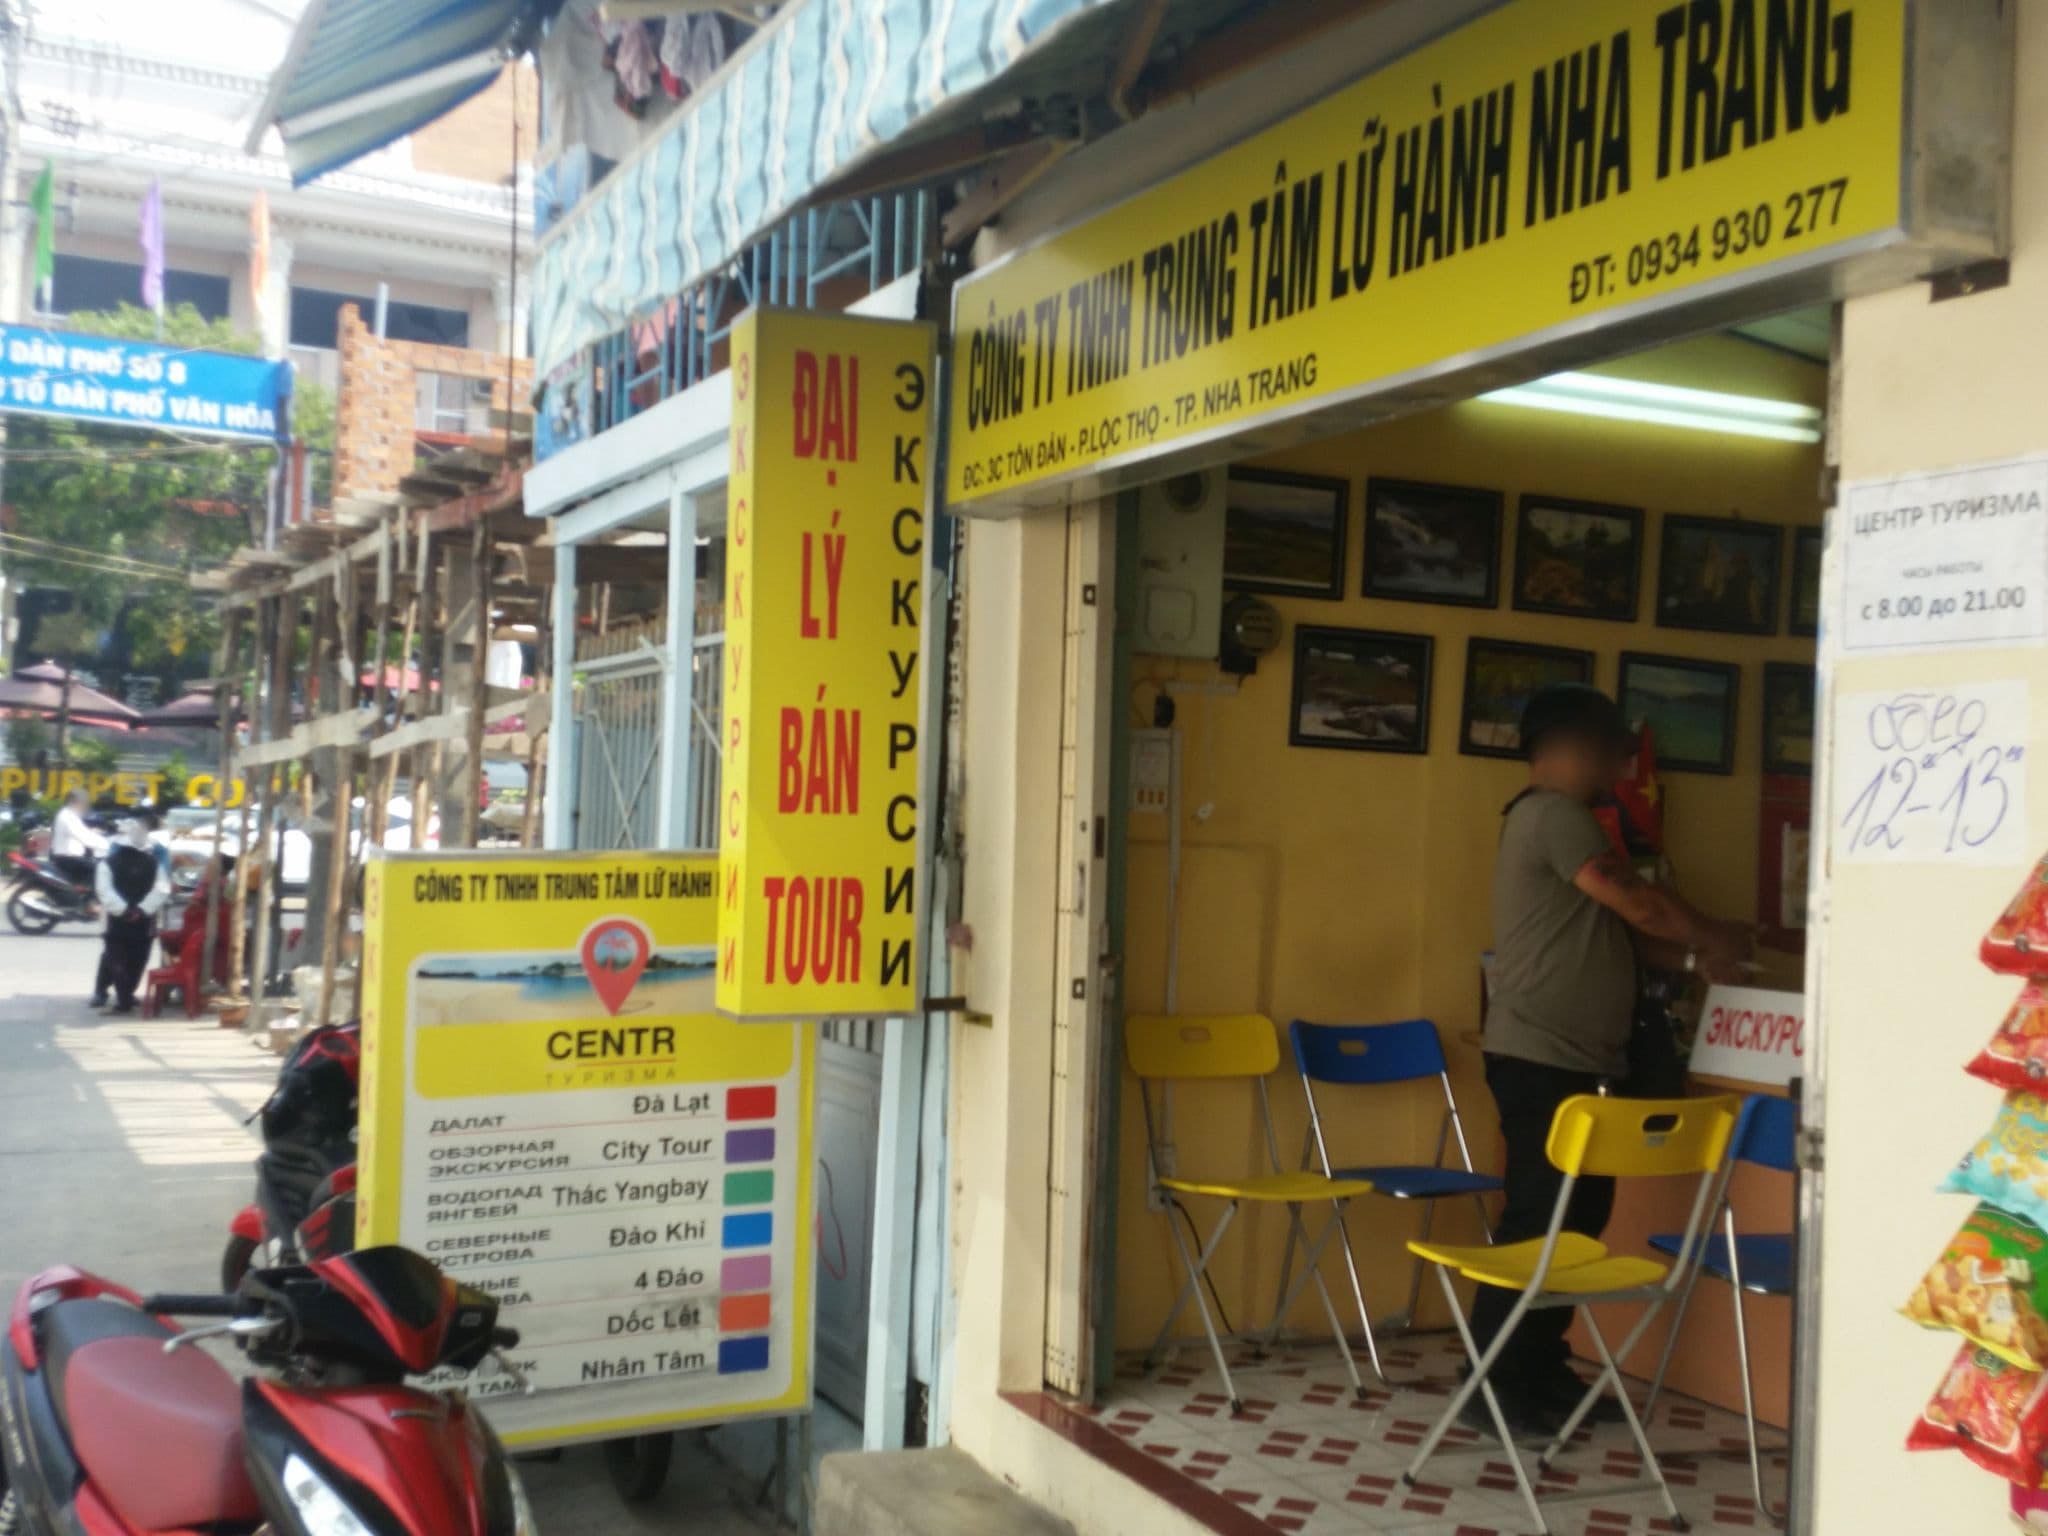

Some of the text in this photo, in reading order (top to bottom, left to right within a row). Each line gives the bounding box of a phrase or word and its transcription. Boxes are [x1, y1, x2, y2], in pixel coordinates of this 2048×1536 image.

[968, 300, 1027, 431] CÔNG
[1033, 296, 1061, 409] TY
[1066, 260, 1134, 396] TNHH
[1141, 211, 1238, 368] TRUNG
[1248, 160, 1323, 331] TÂM
[1389, 83, 1515, 279] HÀNH
[1524, 30, 1630, 229] NHA
[1655, 0, 1853, 180] TRANG
[1570, 178, 1848, 304] ĐT: 0934 930 277
[1175, 393, 1198, 427] TP.
[1203, 379, 1242, 418] NHA
[1248, 353, 1318, 405] TRANG
[1855, 490, 2041, 537] ЦЕНТР ТУРИЗМА
[800, 509, 846, 640] LÝ
[1878, 595, 1923, 620] 8.00
[1927, 597, 1957, 620] до
[1964, 585, 2026, 613] 21.00
[880, 363, 926, 987] ЭКСКУРСИИ
[778, 684, 861, 815] BÁN
[1, 767, 165, 806] PUPPET
[414, 868, 463, 902] CÔNG
[468, 874, 489, 901] TY
[495, 872, 538, 901] TNHH
[545, 872, 599, 900] TRUNG
[605, 866, 638, 899] TÂM
[764, 875, 864, 985] TOUR
[547, 1026, 675, 1060] CENTR
[545, 1067, 676, 1086] ТУРИЗМА
[673, 1092, 710, 1115] Lạt
[429, 1115, 505, 1134] ДАЛАТ
[429, 1140, 555, 1160] ОБЗОРНАЯ
[602, 1136, 713, 1164] City Tour
[428, 1155, 569, 1178] ЭКСКУРСИЯ
[427, 1185, 543, 1206] ВОДОПАД
[552, 1177, 709, 1207] Thác Yangbay
[427, 1203, 518, 1223] ЯНГБЕЙ
[426, 1229, 551, 1252] СЕВЕРНЫЕ
[634, 1271, 649, 1290] 4
[607, 1309, 655, 1335] Dốc
[582, 1351, 705, 1381] Nhân Tâm
